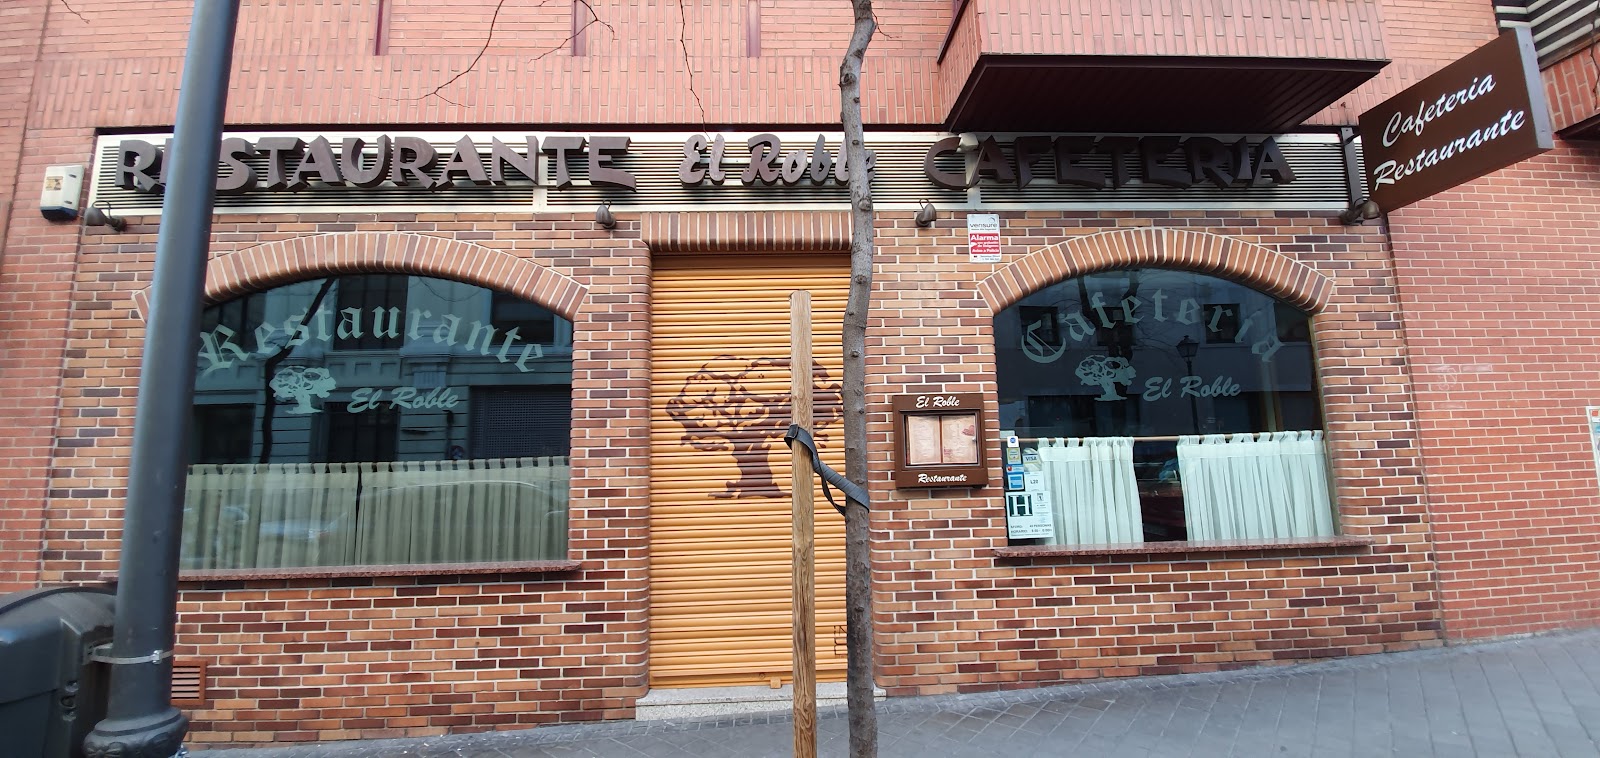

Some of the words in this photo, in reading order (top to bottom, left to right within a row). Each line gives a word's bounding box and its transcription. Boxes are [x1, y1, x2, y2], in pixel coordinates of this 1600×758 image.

[1382, 74, 1497, 148] Cafeteria
[678, 133, 726, 187] El
[923, 135, 1298, 192] CAFETERIA
[1373, 109, 1526, 192] Restaurante
[197, 304, 545, 376] Restaurante
[1020, 288, 1286, 364] Cafeteria
[346, 387, 380, 414] El
[388, 386, 460, 411] Roble
[916, 395, 930, 409] El
[932, 395, 961, 408] Roble
[1143, 376, 1173, 401] El
[1180, 375, 1242, 399] Roble
[917, 473, 968, 484] Restaurante
[1009, 494, 1033, 517] H
